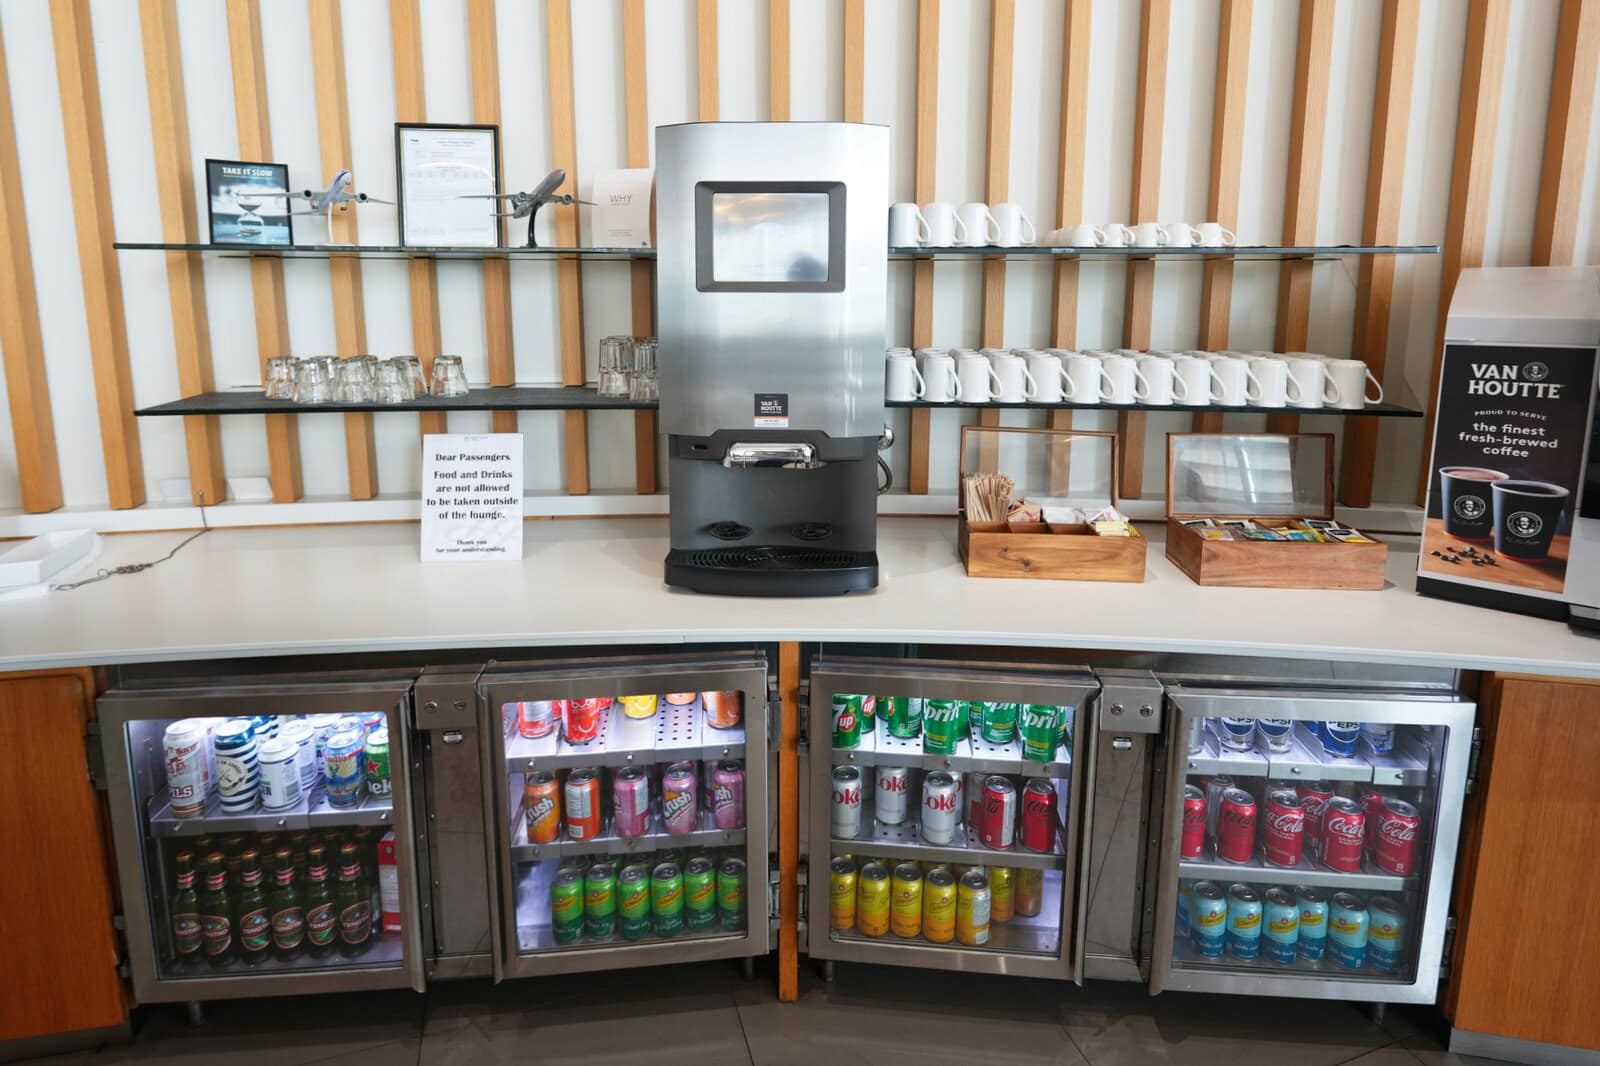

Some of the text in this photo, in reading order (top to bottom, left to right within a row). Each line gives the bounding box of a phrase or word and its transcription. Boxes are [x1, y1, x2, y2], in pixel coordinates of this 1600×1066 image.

[252, 169, 273, 177] SLOW
[609, 193, 633, 203] WHY
[1471, 363, 1519, 380] VAN
[1467, 380, 1561, 399] HOUTTE
[1474, 409, 1504, 417] PROUD
[1519, 410, 1548, 421] SERVE
[1472, 422, 1546, 437] the finest
[1458, 431, 1559, 449] fresh-brewed
[435, 453, 457, 462] Dear
[1482, 446, 1530, 458] coffee
[433, 469, 513, 480] Food and Drinks
[435, 483, 510, 493] are not allowed
[426, 497, 519, 507] to be taken outside
[438, 510, 505, 521] of the lounge.
[527, 798, 555, 826] rush
